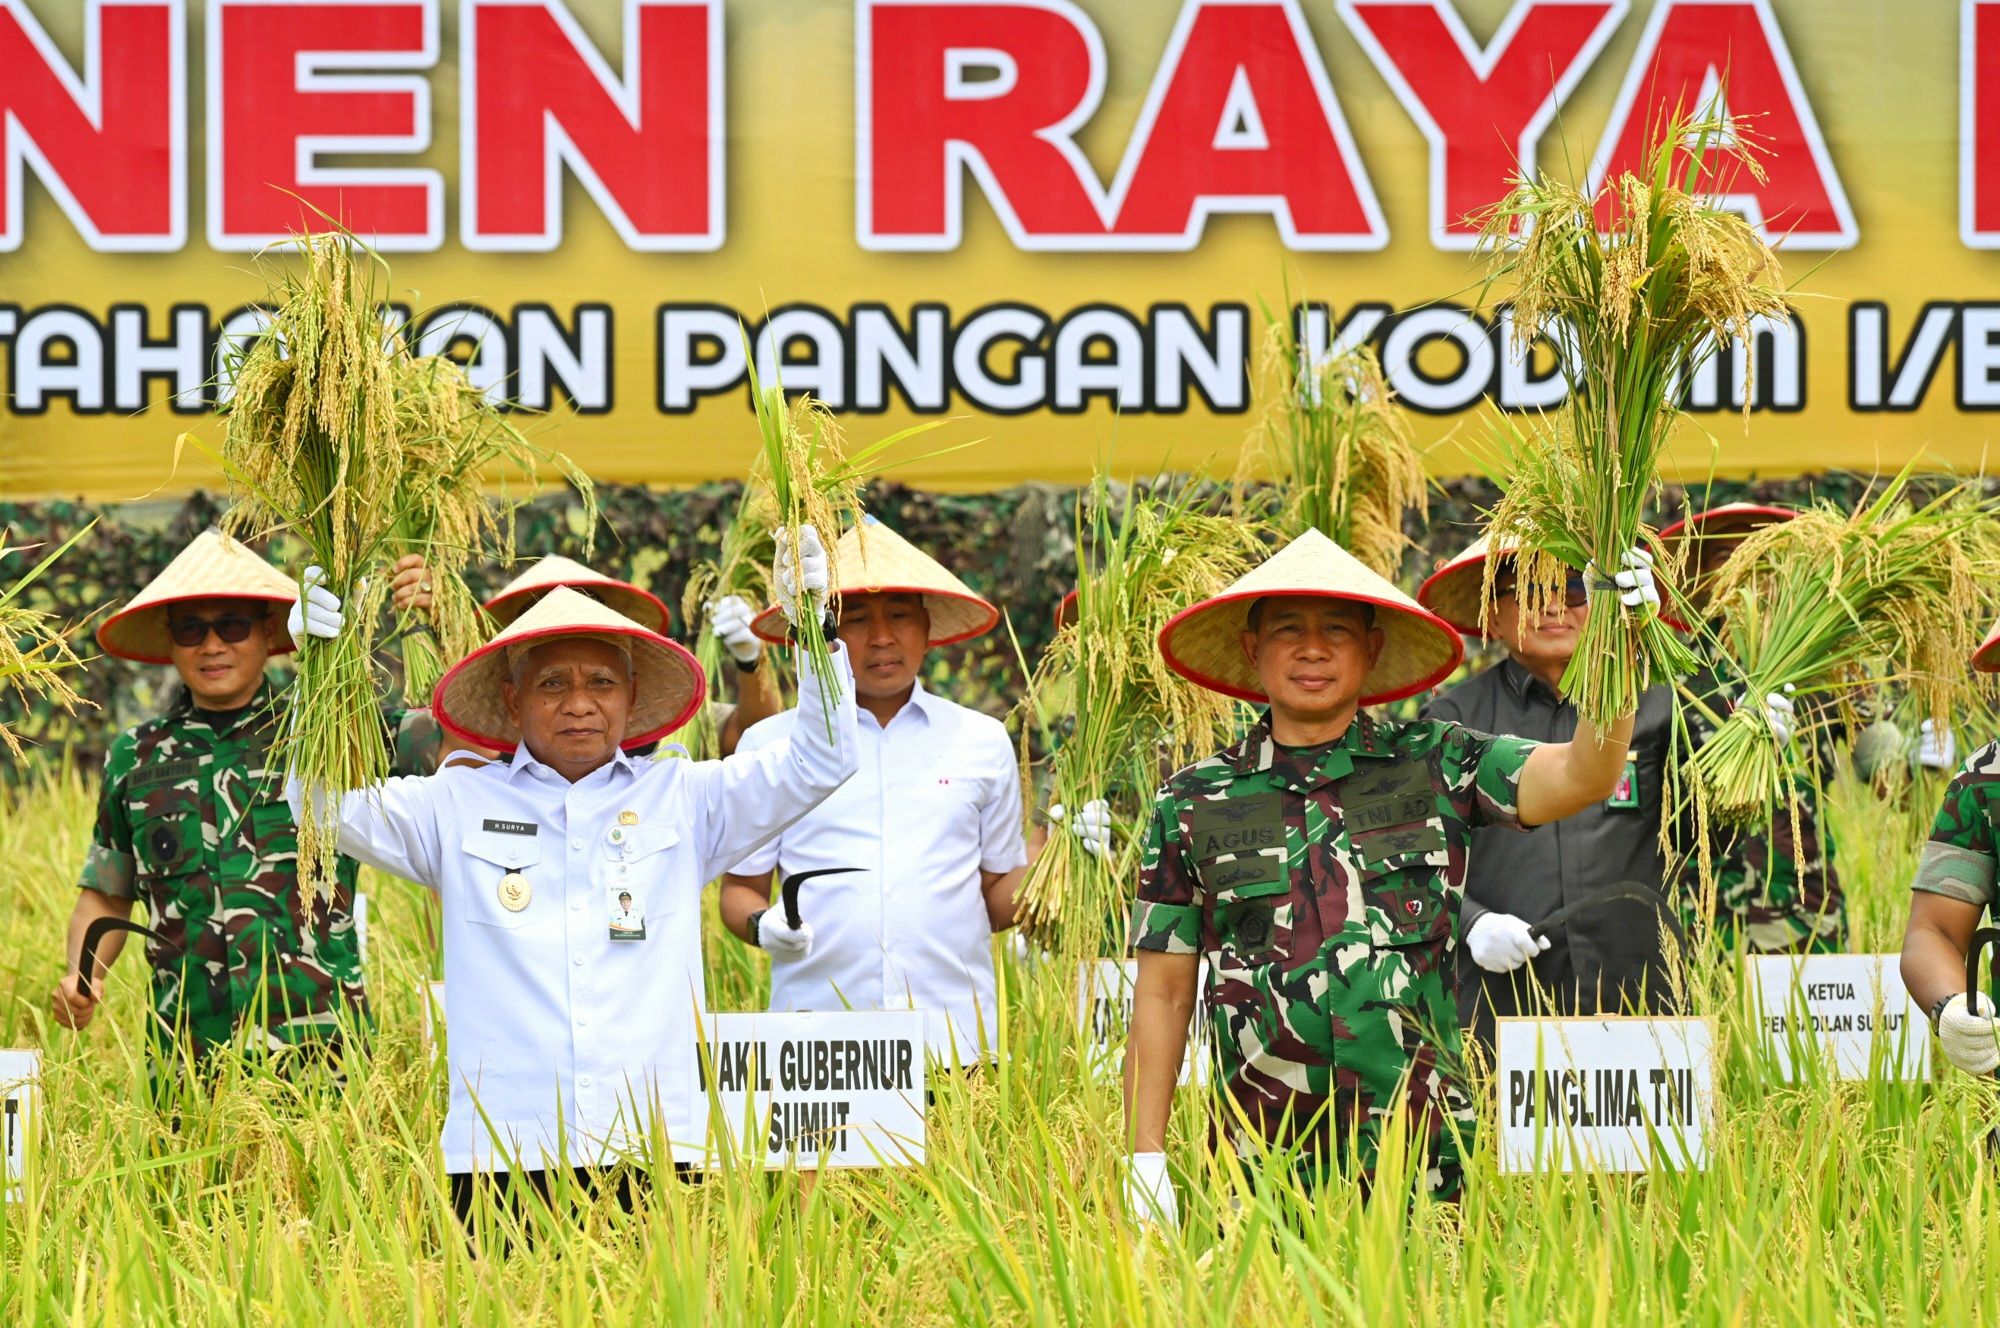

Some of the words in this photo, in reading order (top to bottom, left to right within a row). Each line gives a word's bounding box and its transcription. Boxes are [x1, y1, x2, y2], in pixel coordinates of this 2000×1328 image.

[0, 0, 726, 252] NEN
[856, 0, 1859, 252] RAYA
[657, 303, 1250, 414] PANGAN
[1294, 303, 1806, 414] KODM
[501, 823, 525, 831] SURYA
[1353, 809, 1393, 827] TNI
[1402, 799, 1430, 819] AD
[1206, 827, 1275, 853] AGUS
[1807, 983, 1855, 1001] KETUA
[779, 1039, 913, 1092] GUBERNUR
[1510, 1069, 1643, 1128] PANGLIMA
[1649, 1068, 1693, 1127] TNI
[768, 1101, 850, 1153] SUMUT
